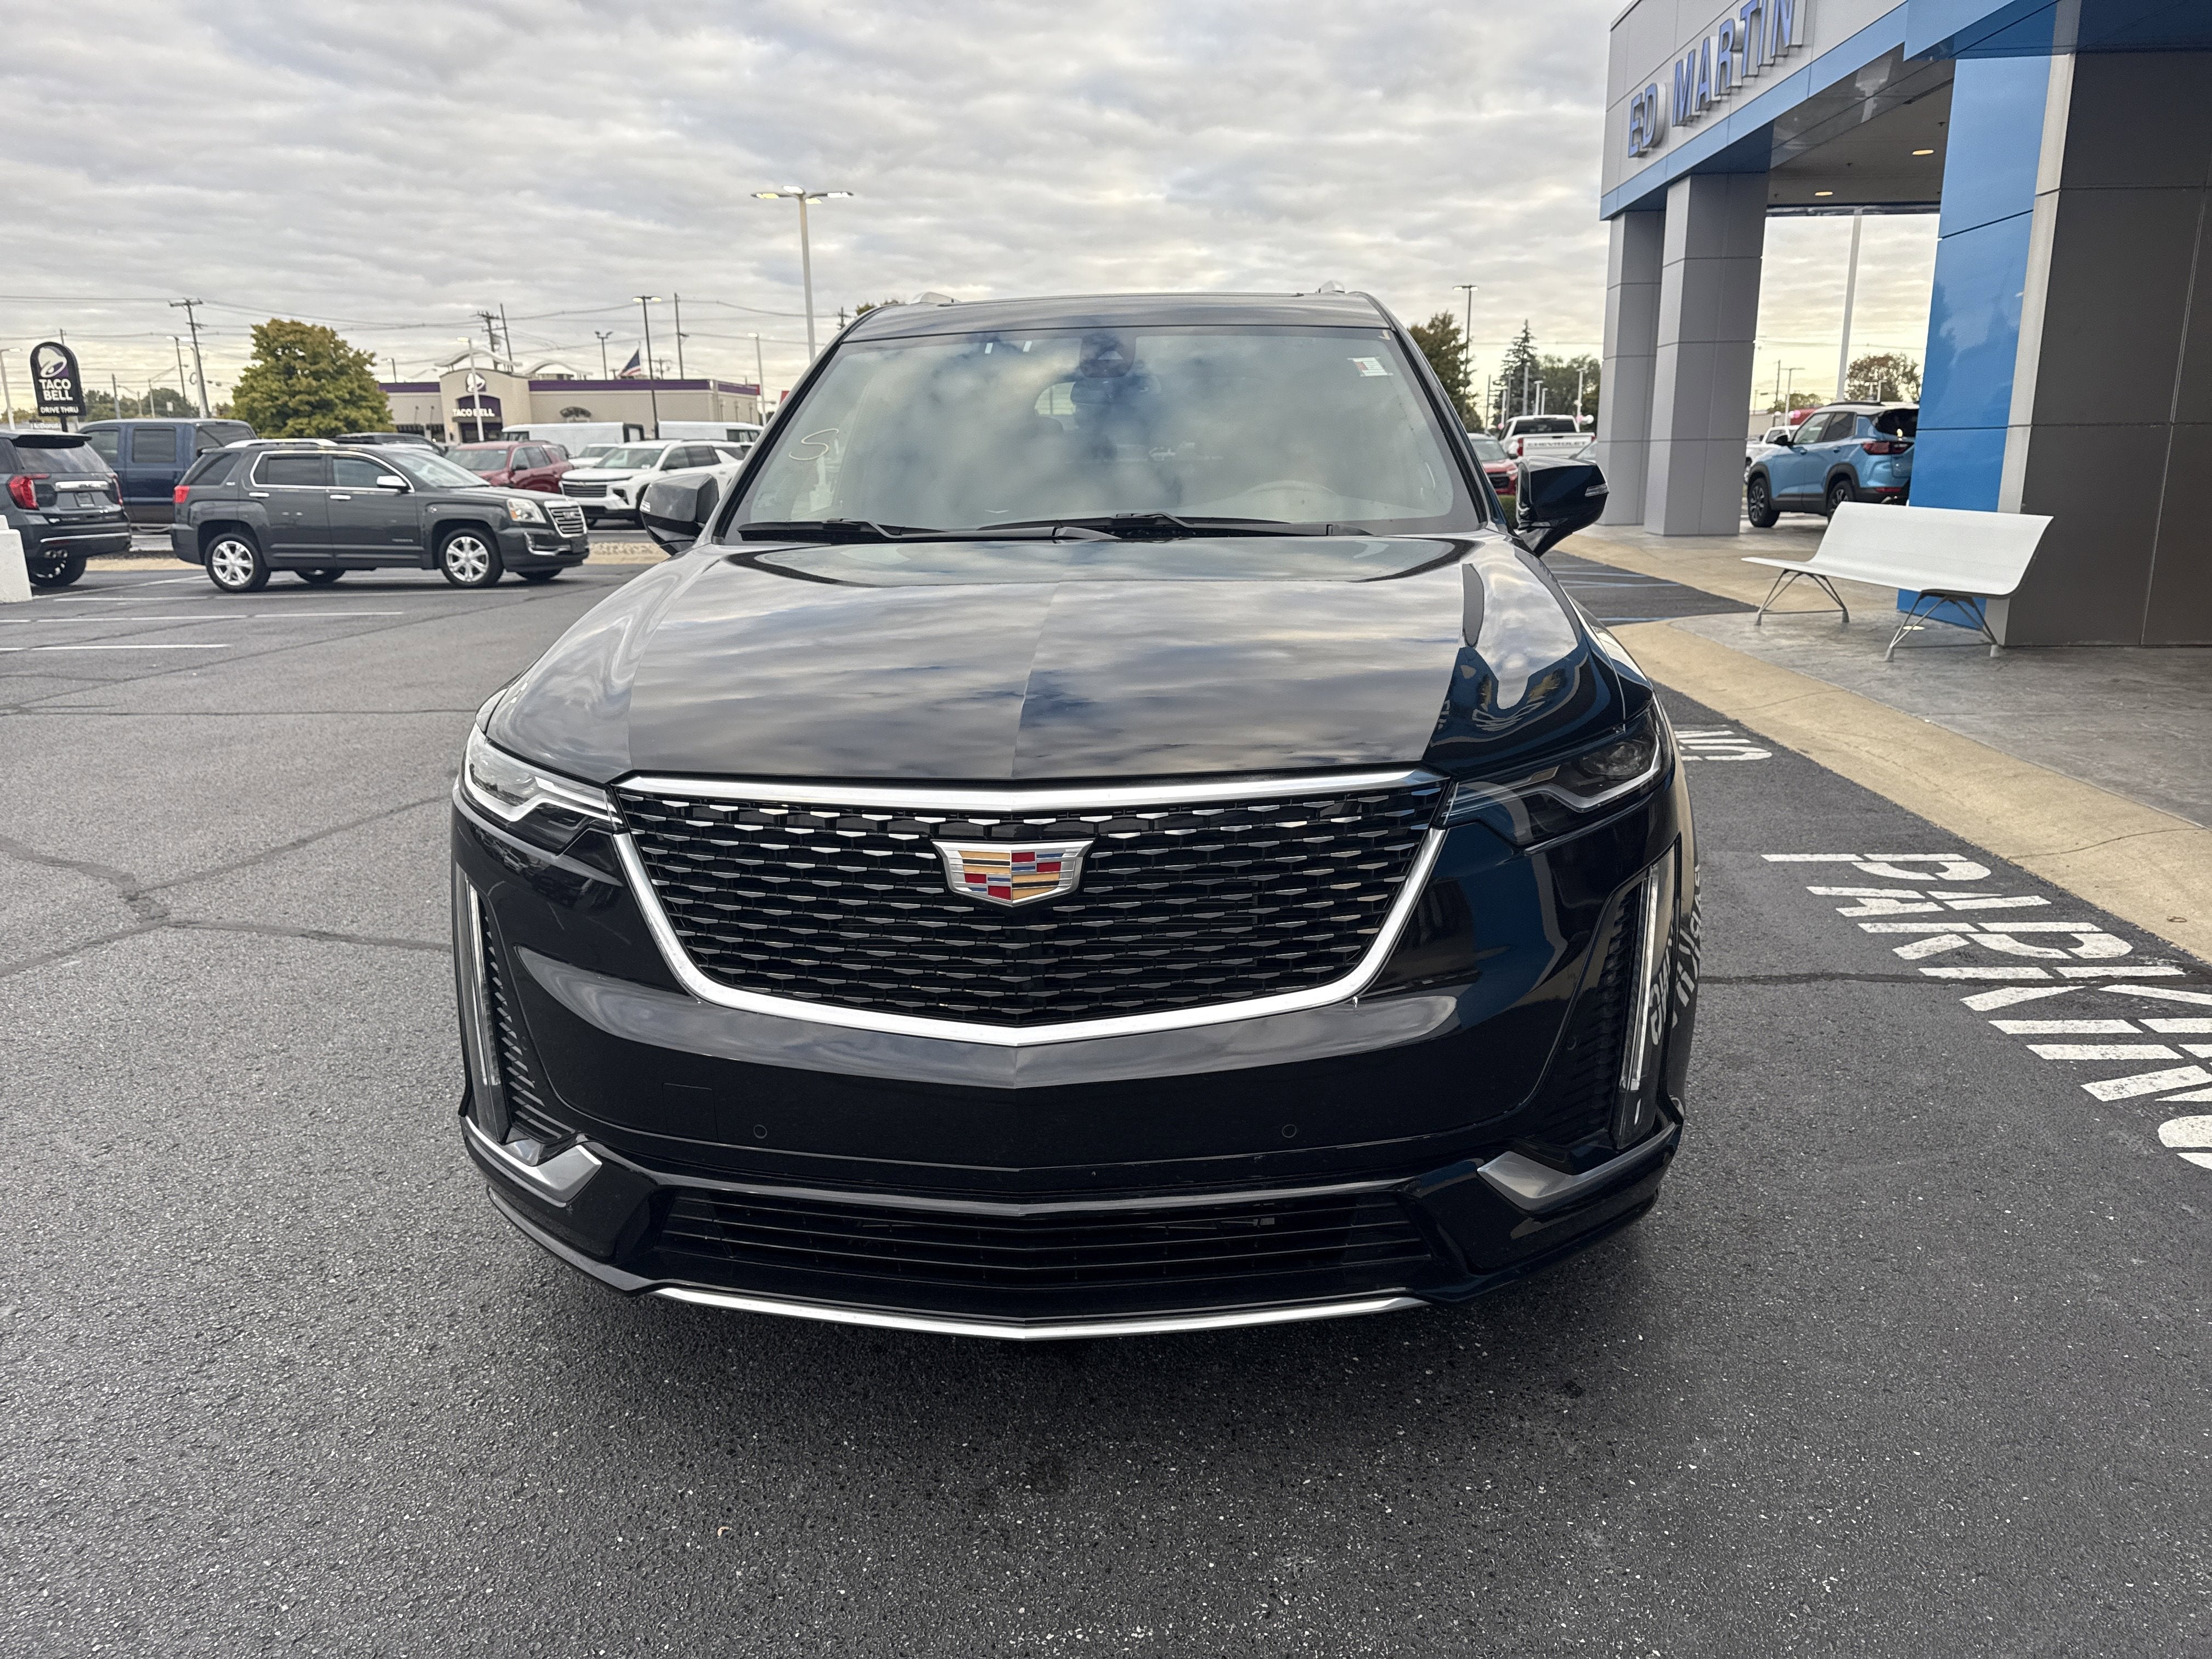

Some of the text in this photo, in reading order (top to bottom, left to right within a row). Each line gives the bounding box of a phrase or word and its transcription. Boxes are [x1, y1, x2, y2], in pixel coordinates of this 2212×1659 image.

[1628, 0, 1803, 158] ED MARTIN
[38, 378, 72, 390] TACO
[43, 390, 74, 401] BELL
[40, 406, 79, 414] DRIVE THRU
[452, 408, 472, 417] TACO
[1760, 853, 2212, 1170] PARKIN
